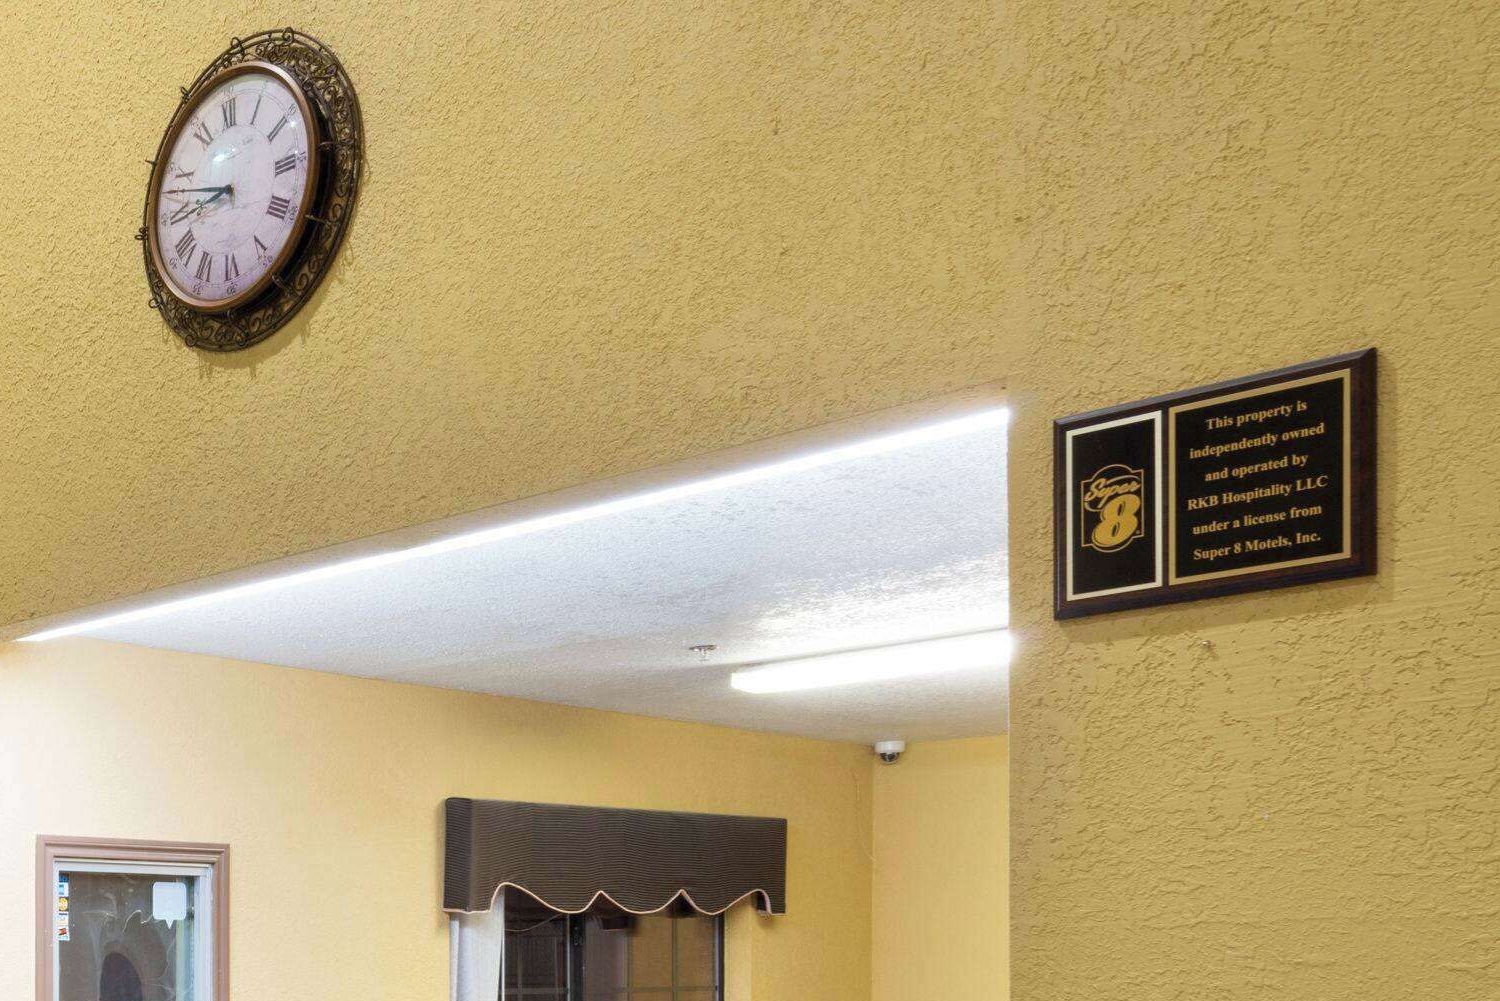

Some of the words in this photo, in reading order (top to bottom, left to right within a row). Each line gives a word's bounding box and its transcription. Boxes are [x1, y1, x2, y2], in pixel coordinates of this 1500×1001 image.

[222, 97, 237, 129] XII
[250, 94, 262, 125] I
[194, 121, 214, 145] XI
[267, 115, 288, 143] II
[274, 153, 296, 176] III
[266, 195, 290, 219] IIII
[175, 228, 197, 267] VIII
[253, 234, 268, 260] V
[196, 251, 213, 282] VII
[224, 252, 239, 282] VI
[1206, 414, 1234, 430] This
[1237, 403, 1292, 428] property
[1297, 400, 1307, 412] is
[1189, 433, 1278, 459] independently
[1282, 423, 1325, 441] owned
[1205, 466, 1228, 481] and
[1232, 459, 1288, 479] operated
[1292, 453, 1309, 470] by
[1084, 478, 1141, 509] Super
[1187, 494, 1219, 511] RKB
[1222, 482, 1292, 506] Hospitality
[1296, 475, 1328, 492] LLC
[1092, 494, 1141, 547] 8
[1193, 519, 1230, 535] under
[1233, 519, 1240, 528] a
[1244, 509, 1286, 526] license
[1290, 504, 1322, 519] from
[1194, 544, 1230, 562] Super
[1234, 542, 1241, 554] 8
[1244, 536, 1293, 553] Motels,
[1296, 532, 1322, 548] Inc.
